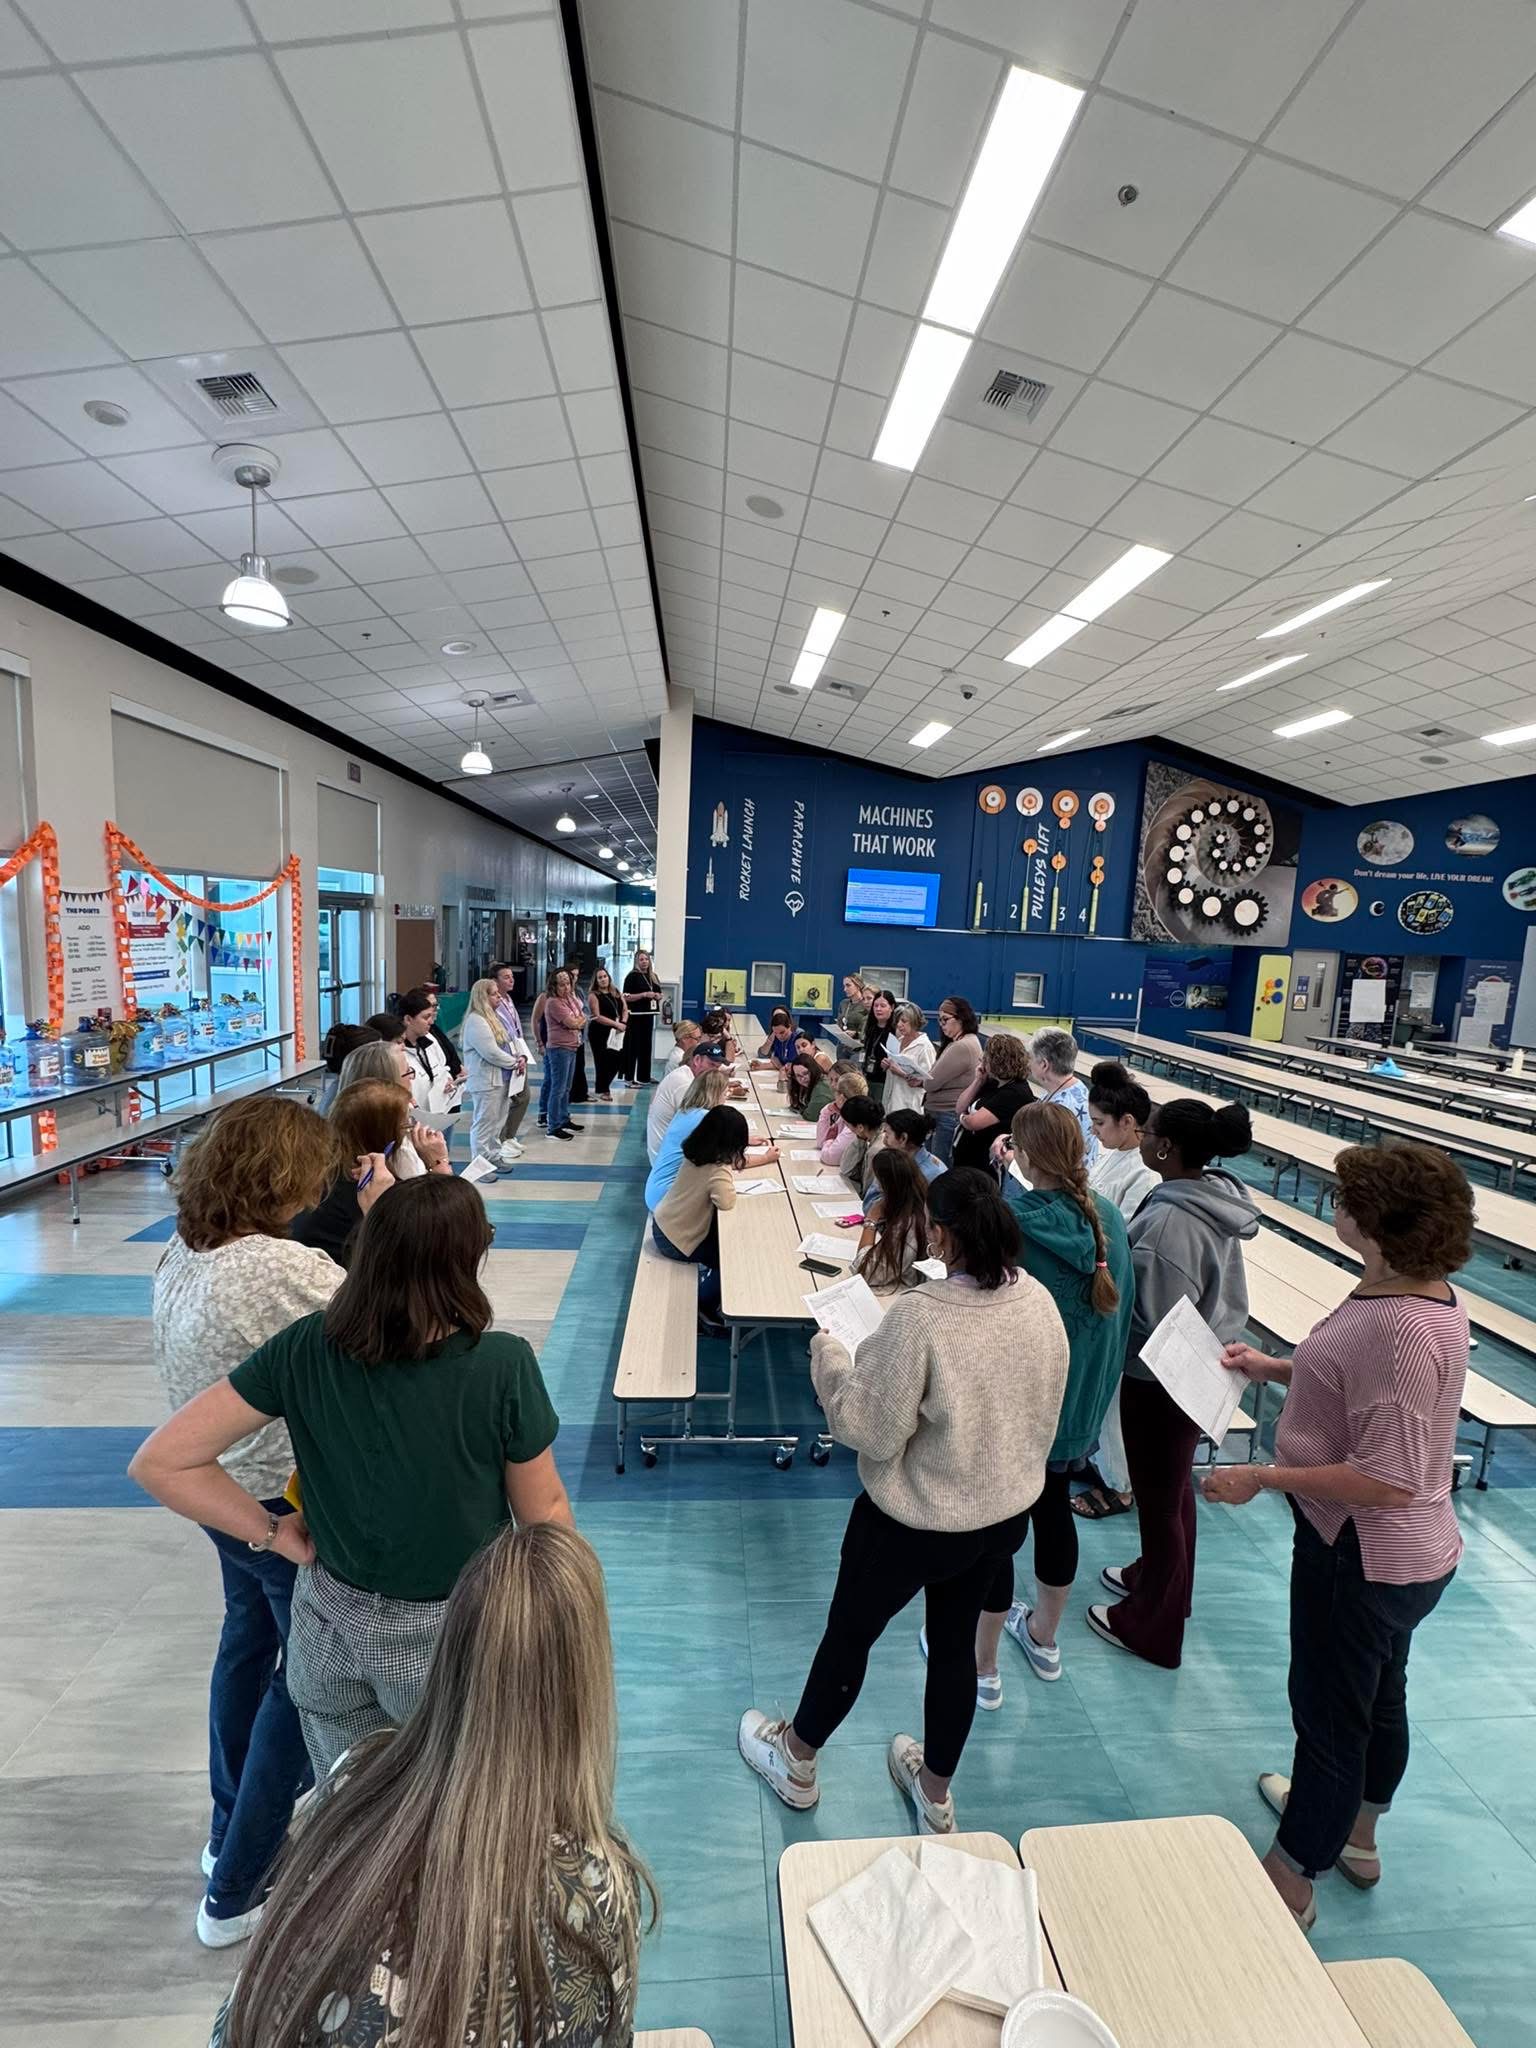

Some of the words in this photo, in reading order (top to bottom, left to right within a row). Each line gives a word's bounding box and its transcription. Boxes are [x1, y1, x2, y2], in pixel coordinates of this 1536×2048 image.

[742, 798, 756, 850] LAUNCH
[858, 804, 934, 829] MACHINES
[791, 800, 805, 885] PARACHUTE
[852, 833, 889, 854] THAT
[892, 836, 936, 858] WORK
[1036, 822, 1050, 854] LIFT
[738, 852, 752, 901] ROCKET
[1353, 868, 1373, 877] Don't
[1374, 870, 1397, 879] dream
[1398, 872, 1415, 881] your
[1430, 872, 1446, 881] LIVE
[1447, 873, 1466, 882] YOUR
[1031, 858, 1048, 920] PULLEYS
[982, 902, 988, 917] 1
[1009, 903, 1018, 919] 2
[1058, 906, 1066, 921] 3
[1078, 907, 1087, 923] 4
[73, 1053, 83, 1064] 3
[28, 1064, 37, 1074] 2
